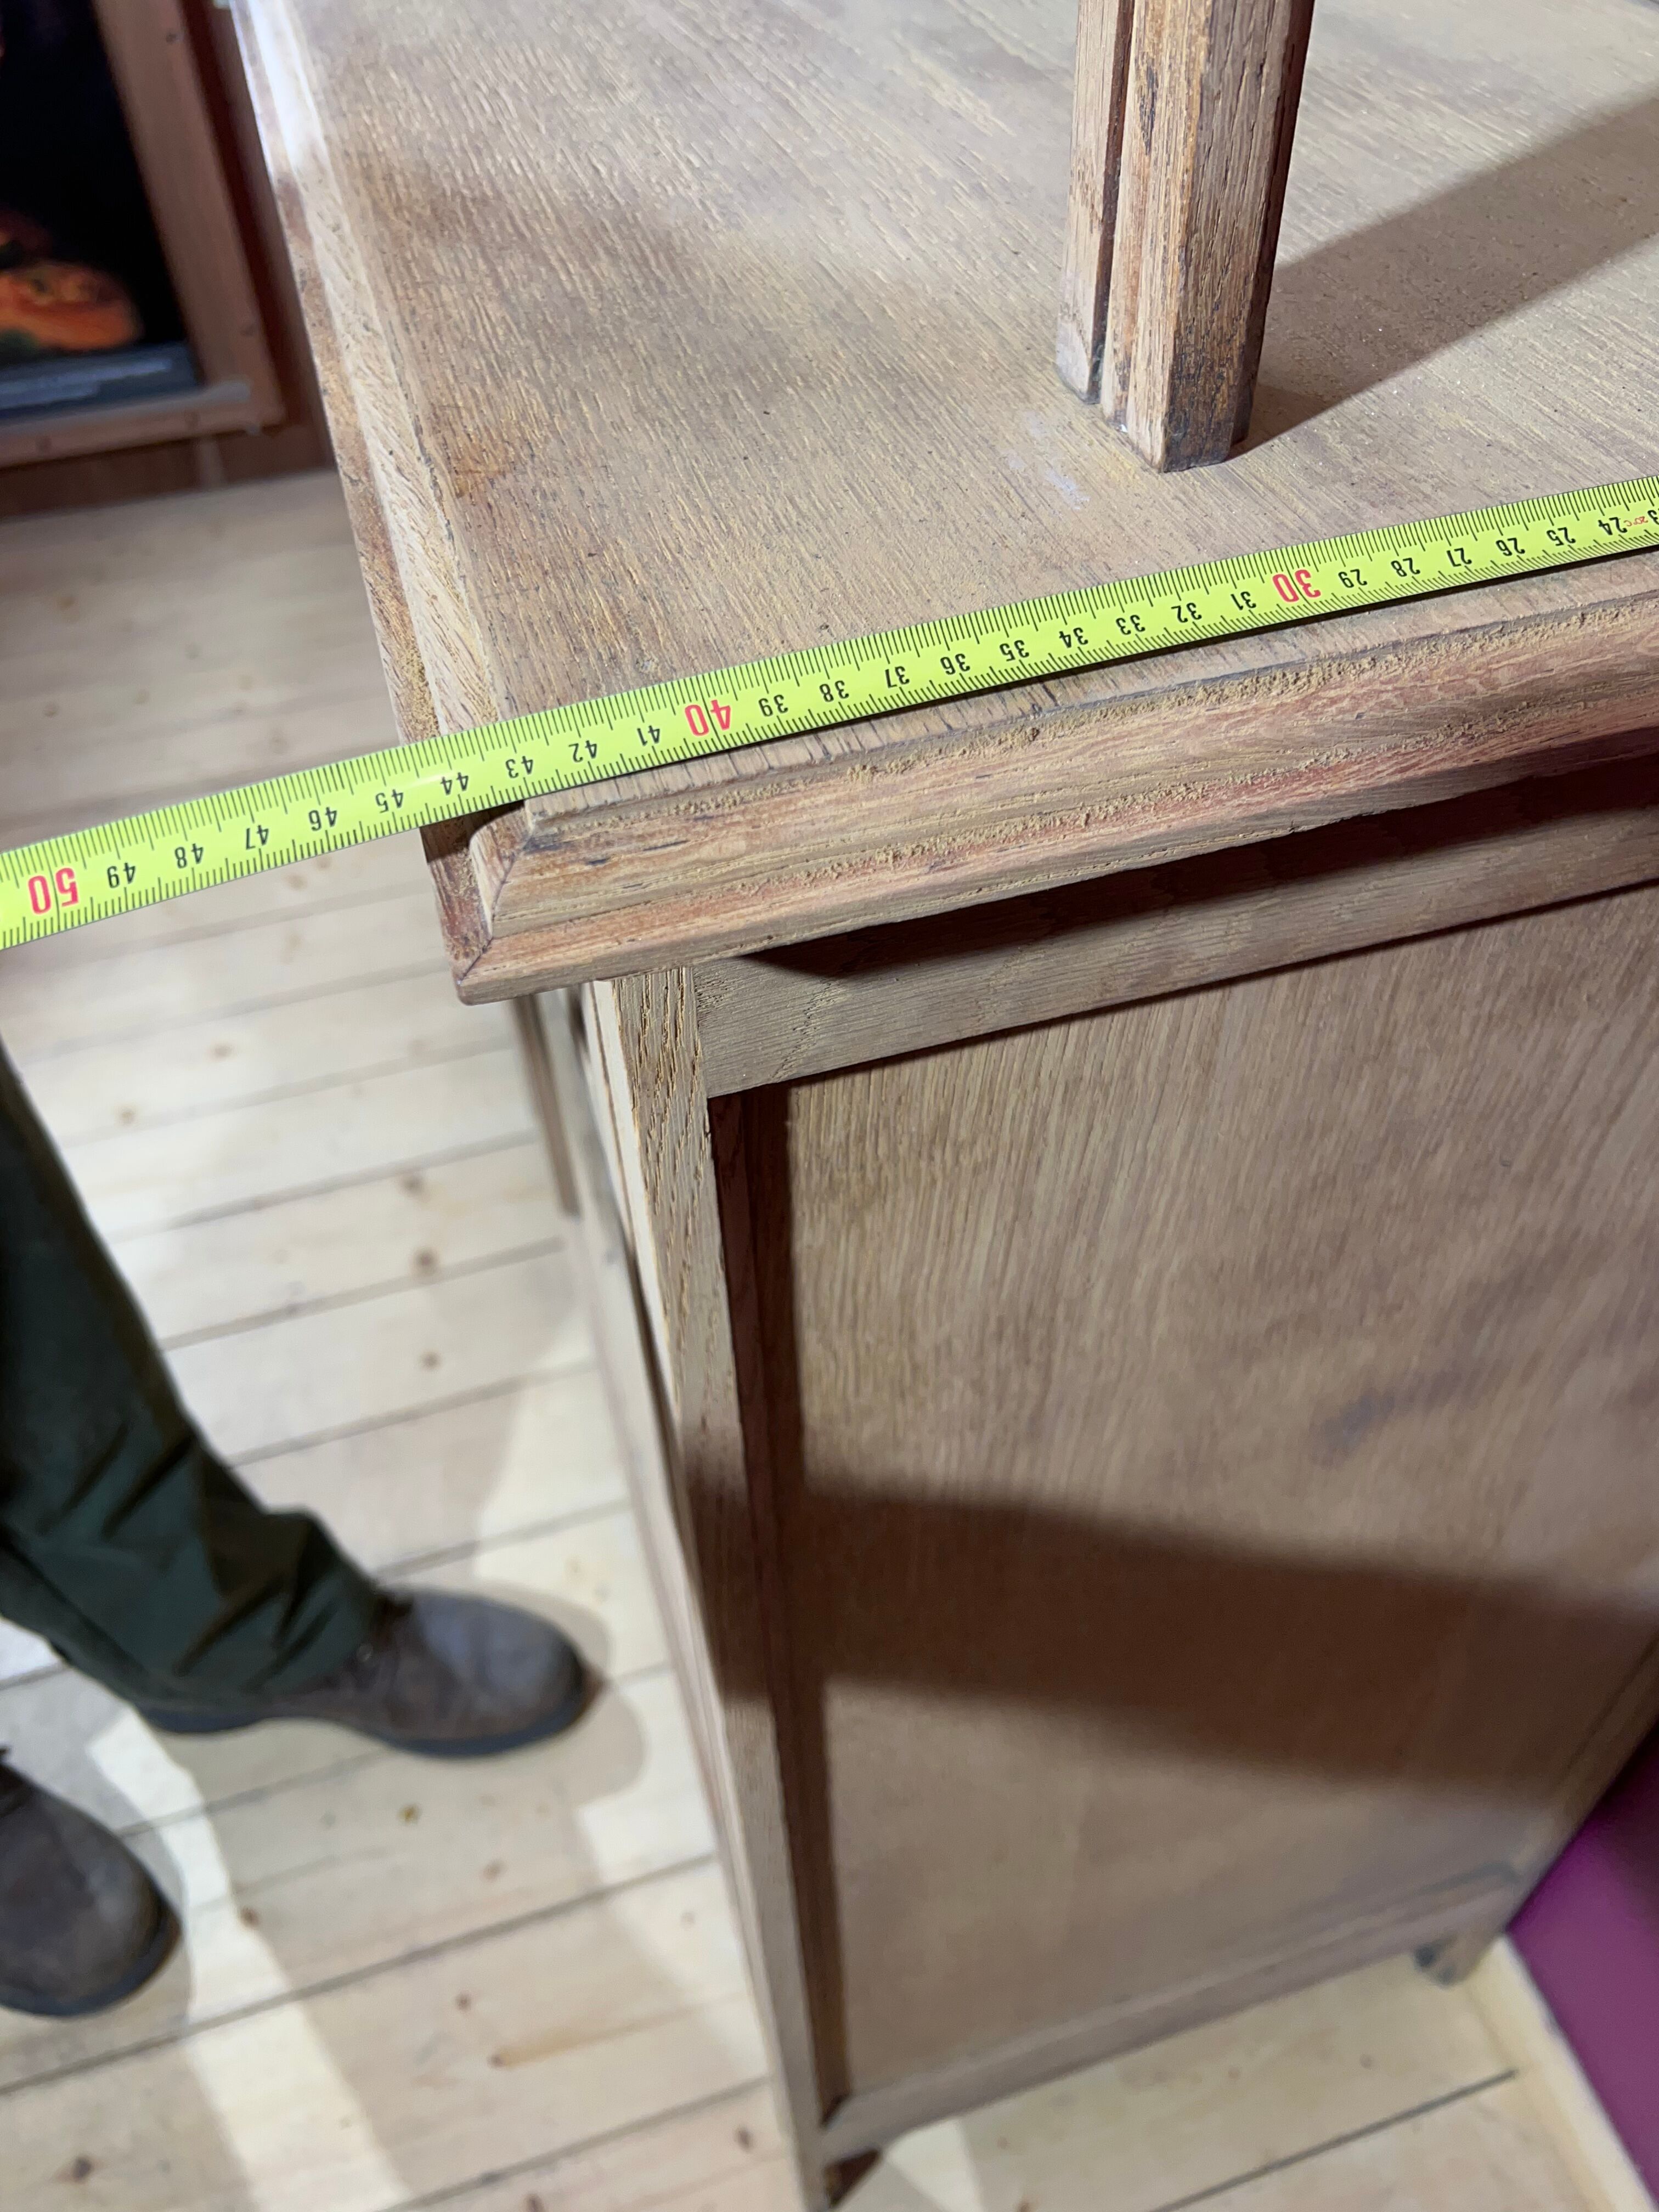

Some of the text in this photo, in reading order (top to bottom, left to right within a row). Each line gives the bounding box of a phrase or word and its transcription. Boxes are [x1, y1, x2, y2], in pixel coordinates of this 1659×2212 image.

[1545, 527, 1577, 546] 25
[1598, 516, 1628, 535] 24
[1446, 547, 1472, 568] 27
[1495, 537, 1526, 557] 26
[1338, 568, 1368, 589] 29
[1390, 557, 1421, 578] 28
[1272, 569, 1322, 603] 30
[1230, 590, 1257, 612] 31
[1170, 602, 1203, 624] 32
[1115, 614, 1146, 636] 33
[1058, 627, 1089, 649] 34
[999, 639, 1030, 662] 35
[940, 652, 971, 675] 36
[884, 665, 910, 689] 37
[818, 679, 850, 703] 38
[758, 694, 789, 717] 39
[684, 699, 732, 737] 40
[636, 725, 661, 746] 41
[568, 740, 598, 763] 42
[505, 755, 535, 779] 43
[439, 771, 469, 795] 44
[375, 788, 404, 813] 45
[308, 806, 338, 831] 46
[244, 824, 270, 850] 47
[174, 843, 205, 868] 48
[106, 862, 137, 889] 49
[27, 867, 80, 916] 50
